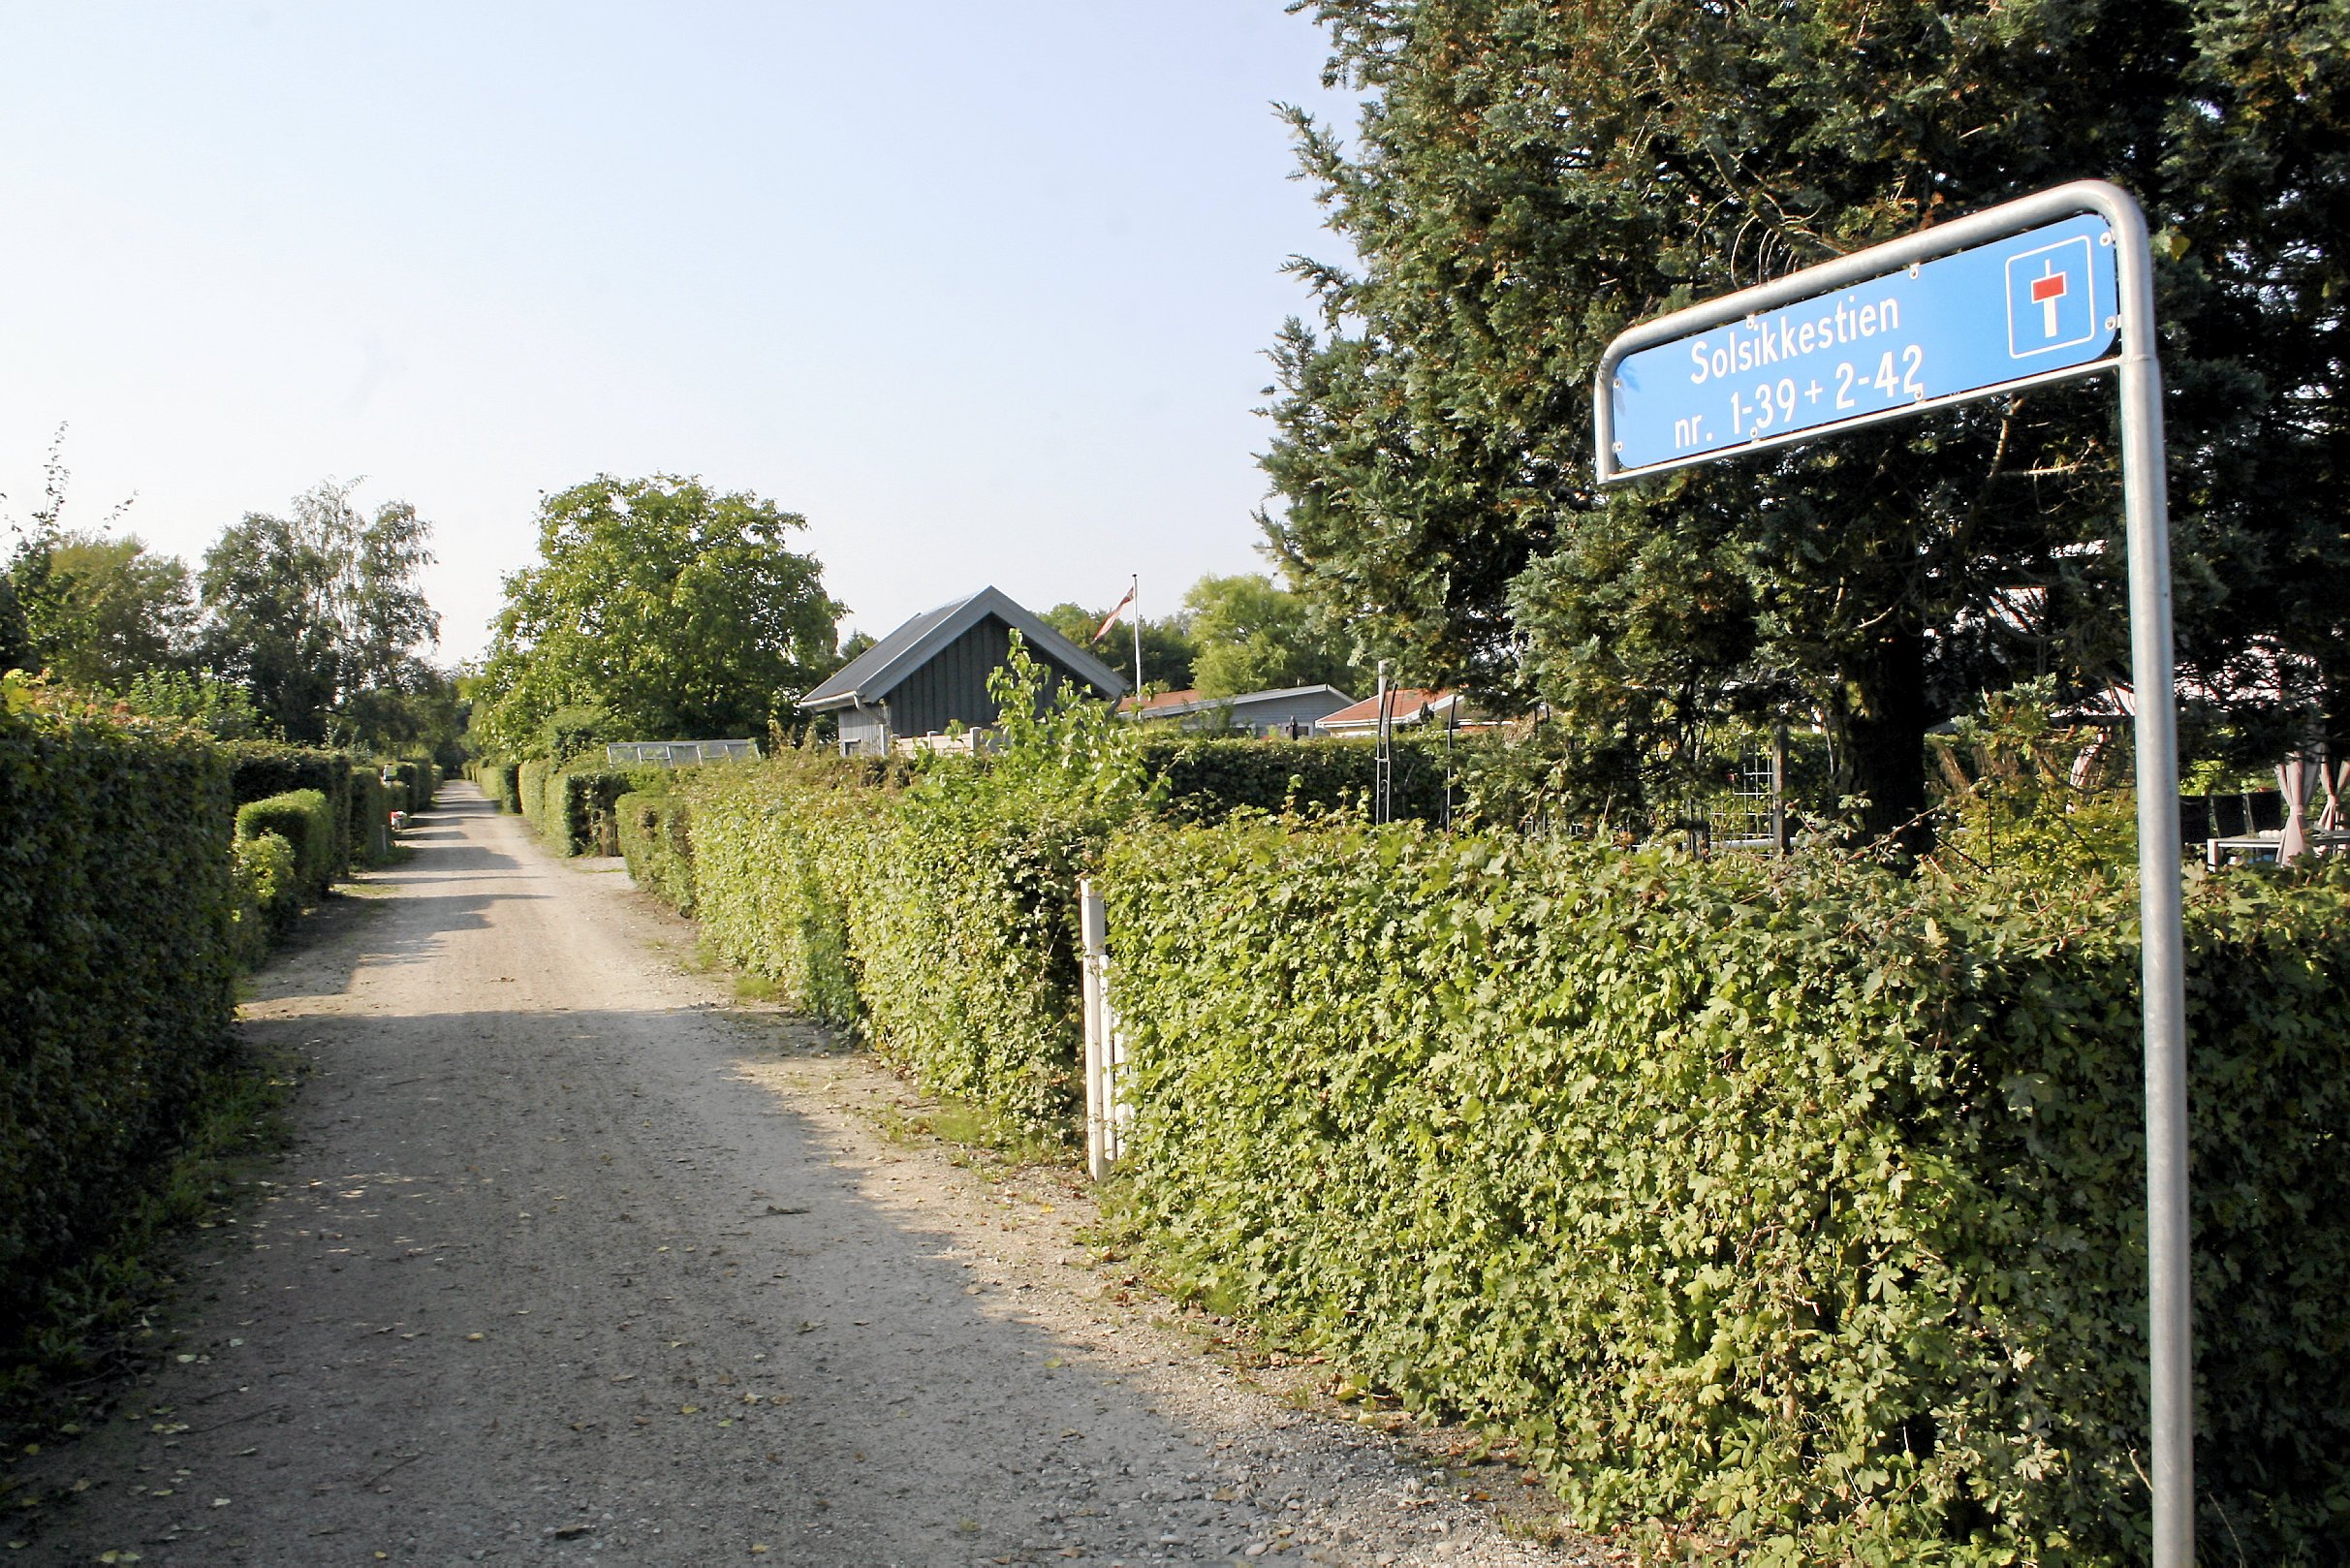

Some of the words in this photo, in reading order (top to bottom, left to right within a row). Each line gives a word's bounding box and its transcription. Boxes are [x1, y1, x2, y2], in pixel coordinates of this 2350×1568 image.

[1690, 295, 1898, 385] Solsikkestien
[1674, 415, 1712, 450] nr.
[1731, 378, 1797, 433] 1-39
[1804, 380, 1824, 405] +
[1834, 344, 1924, 410] 2-42
